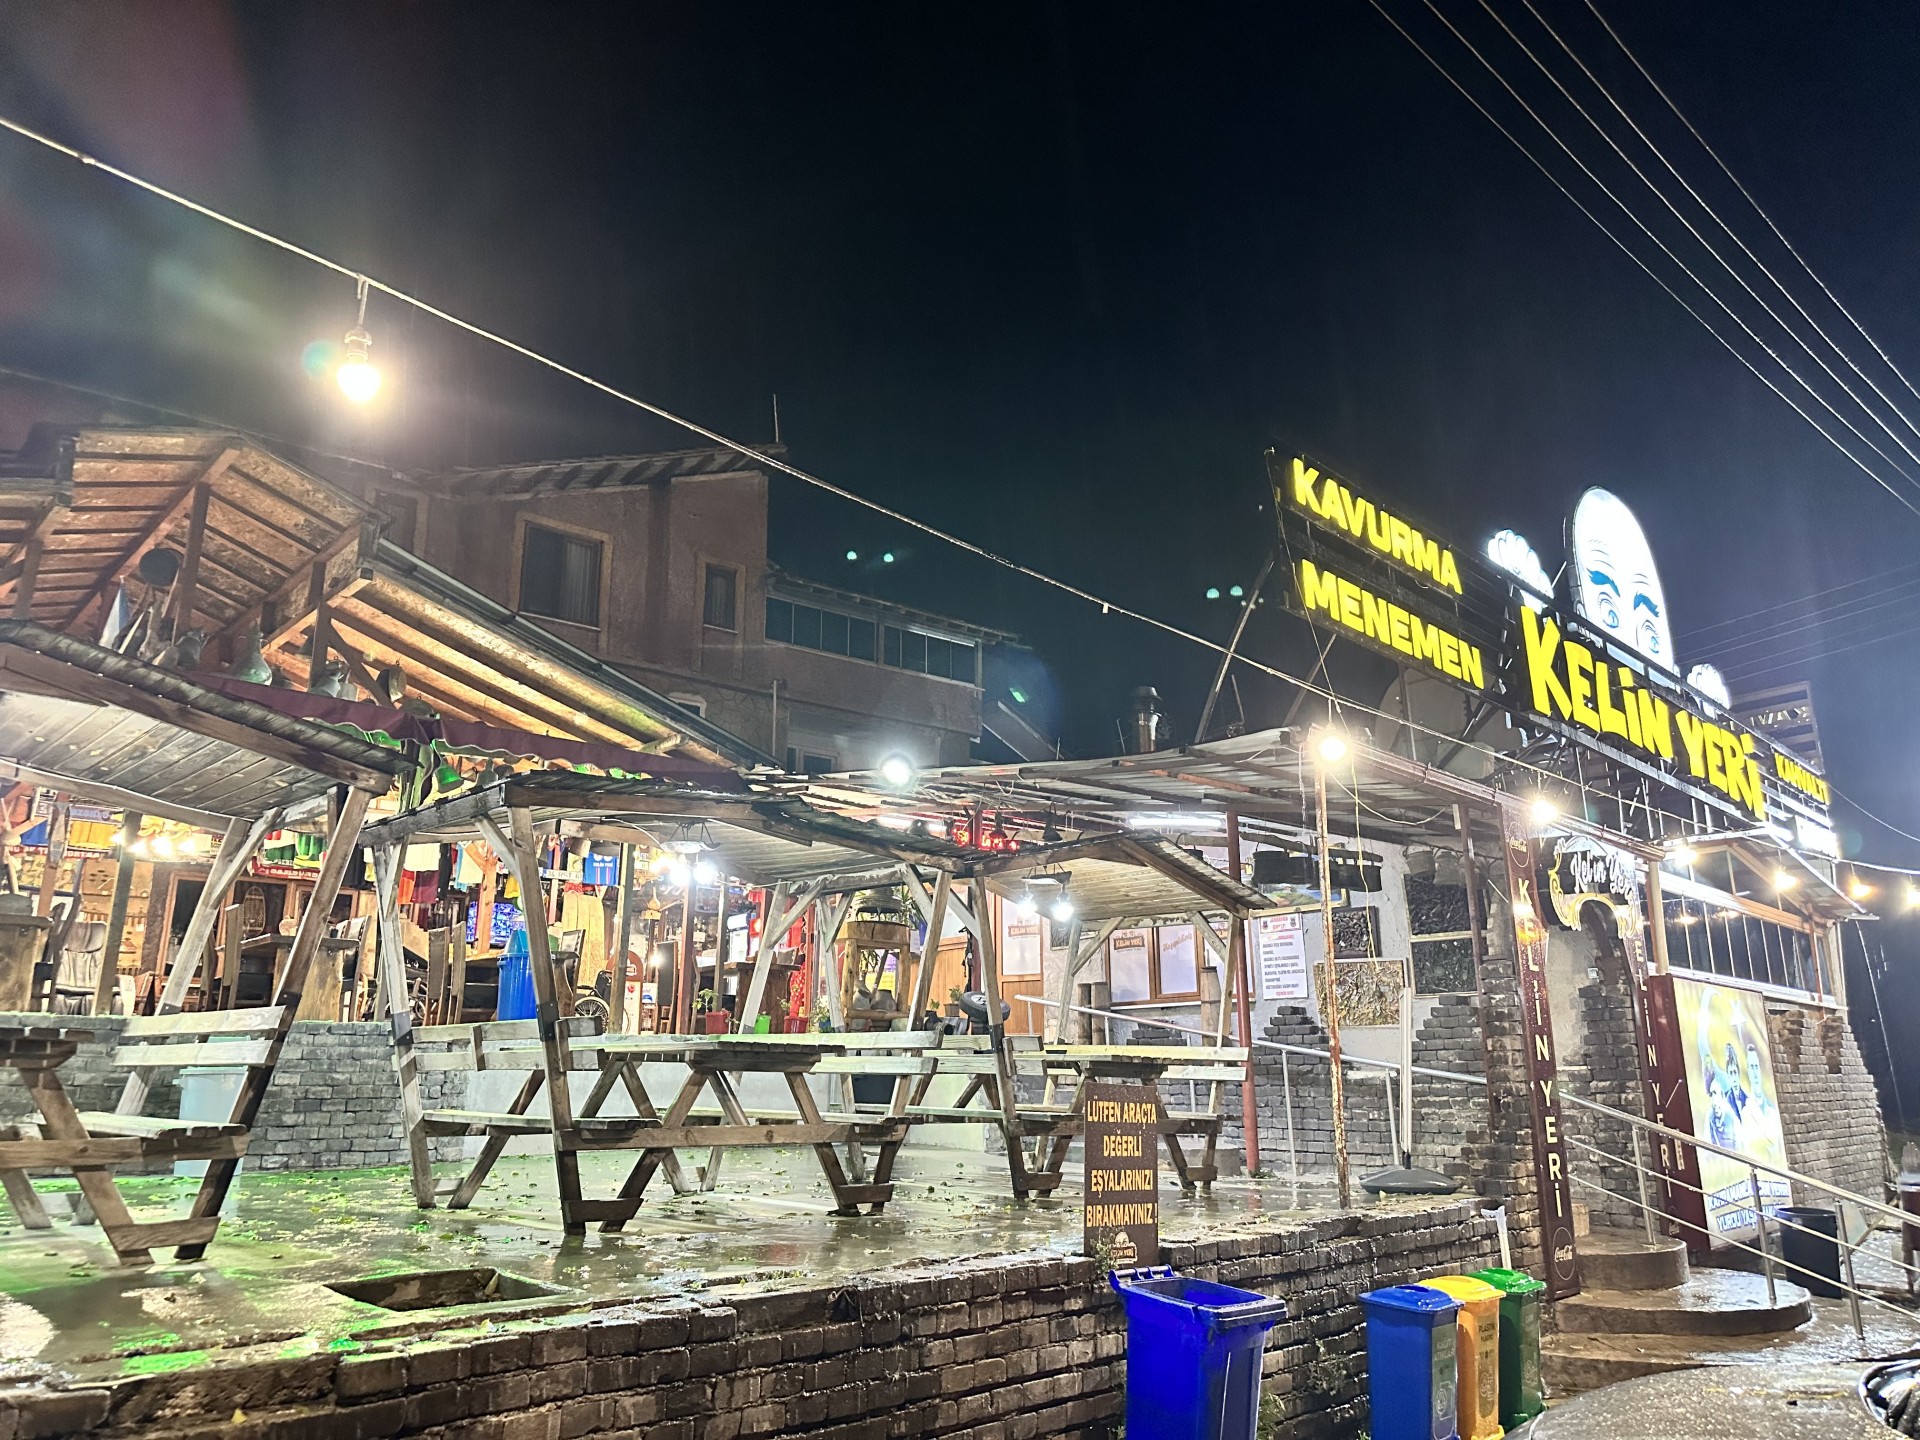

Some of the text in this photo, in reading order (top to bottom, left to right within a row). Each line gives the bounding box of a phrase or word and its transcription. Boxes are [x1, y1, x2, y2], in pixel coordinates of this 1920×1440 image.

[1293, 457, 1463, 596] KAVURMA
[1301, 558, 1485, 690] MENEMEN
[1087, 1095, 1157, 1129] LÜTFEN ARAÇTA
[1103, 1129, 1142, 1157] DEĞERLİ
[1091, 1169, 1153, 1198] EŞYALARINIZI
